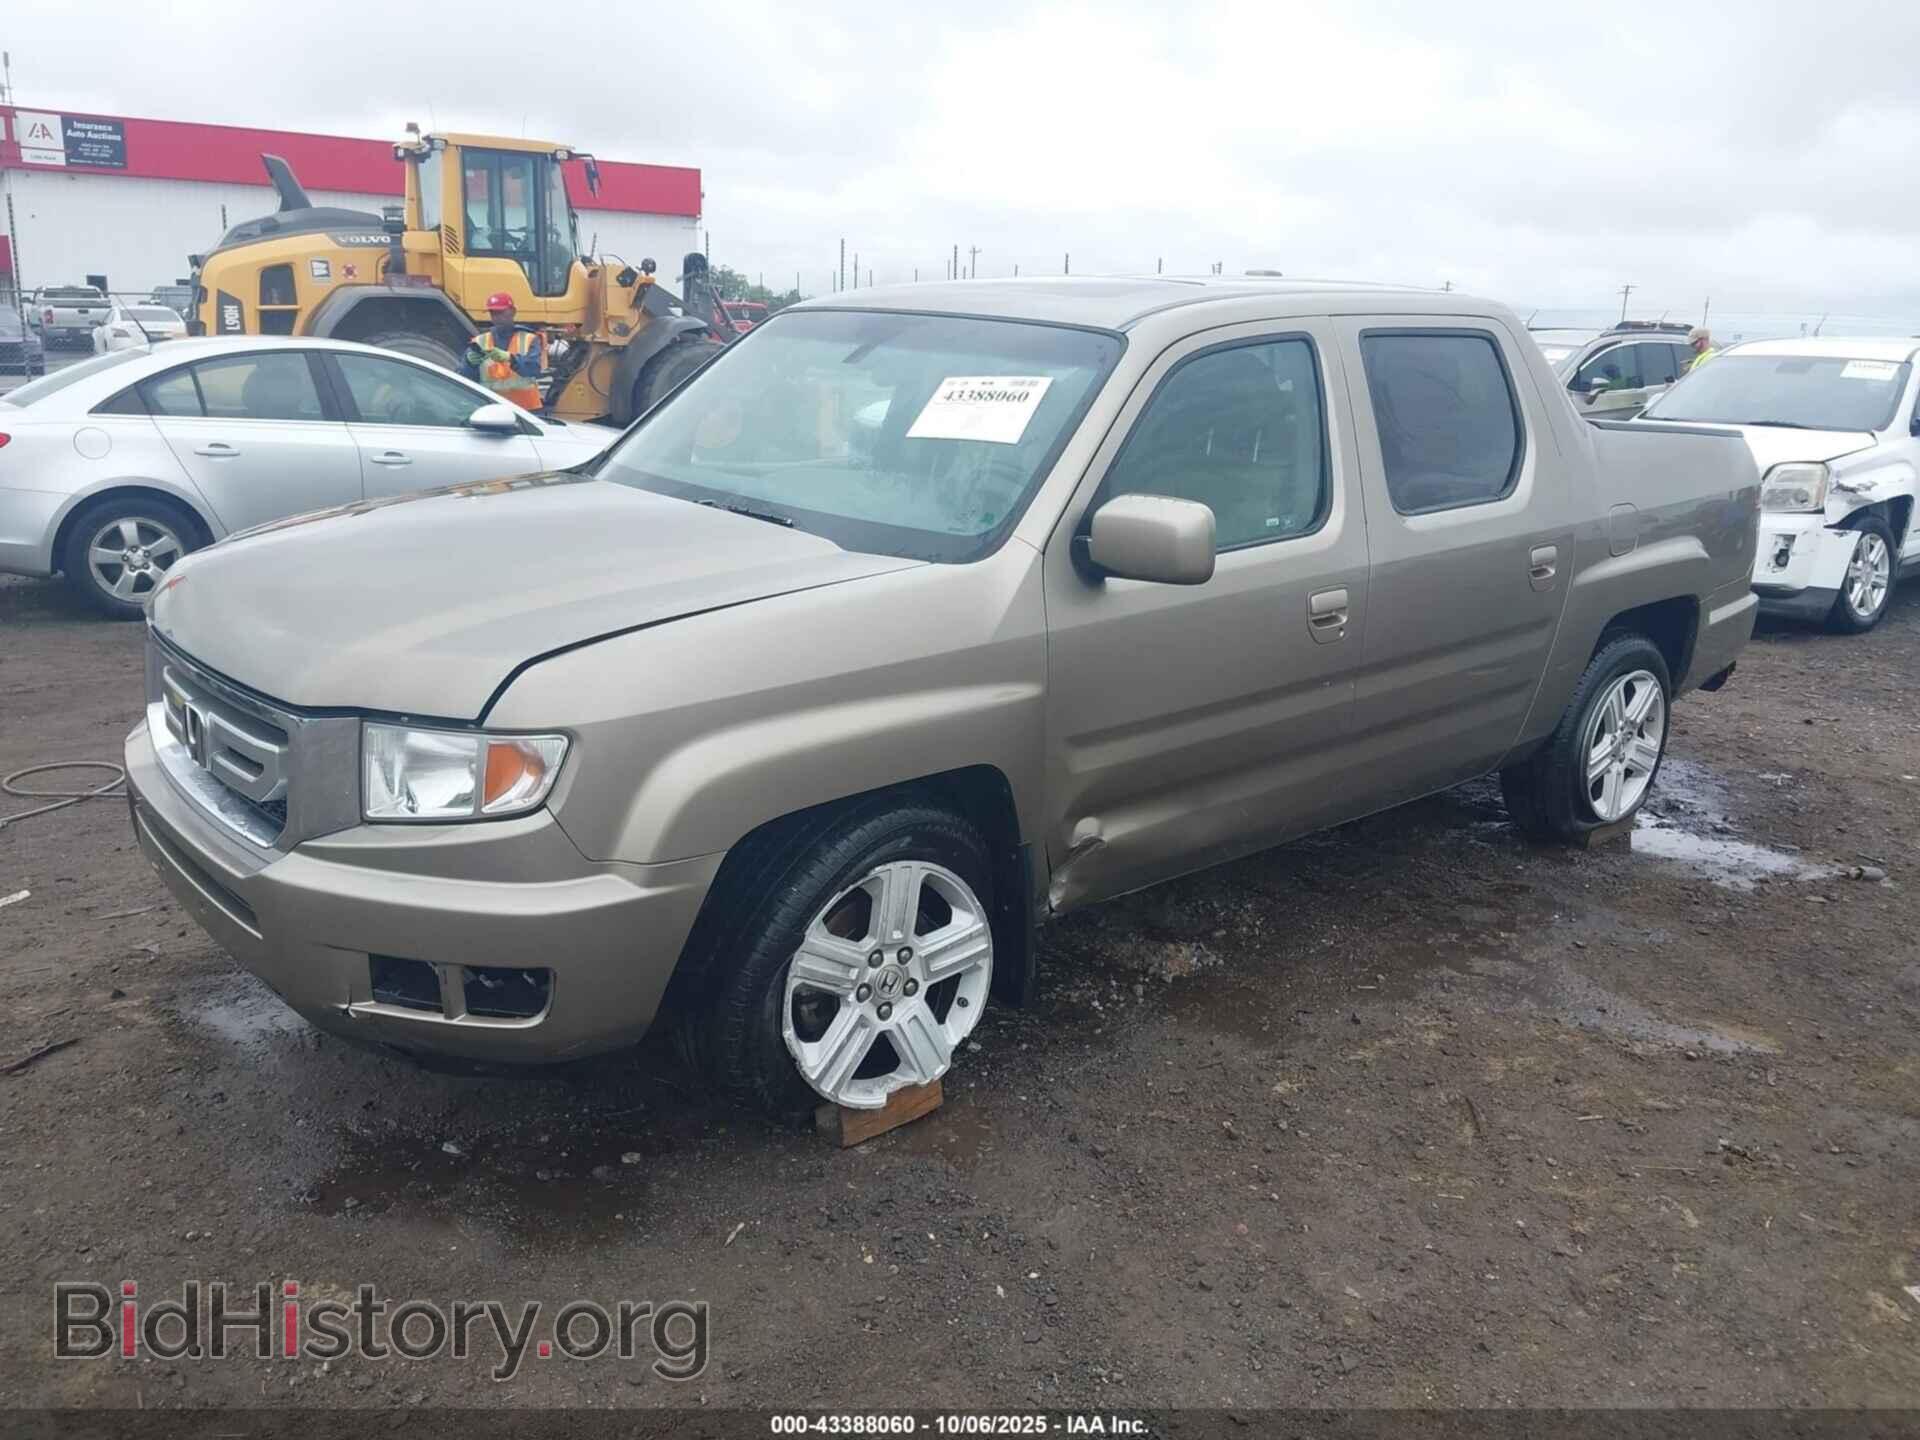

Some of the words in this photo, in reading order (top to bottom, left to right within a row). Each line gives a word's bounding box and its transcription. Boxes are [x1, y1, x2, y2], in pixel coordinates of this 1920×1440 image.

[73, 120, 113, 131] Insurance
[66, 128, 85, 138] Auto
[87, 130, 122, 141] Auctions
[337, 234, 391, 244] VOLVO
[224, 305, 241, 330] L90H
[943, 389, 1030, 403] 43388060
